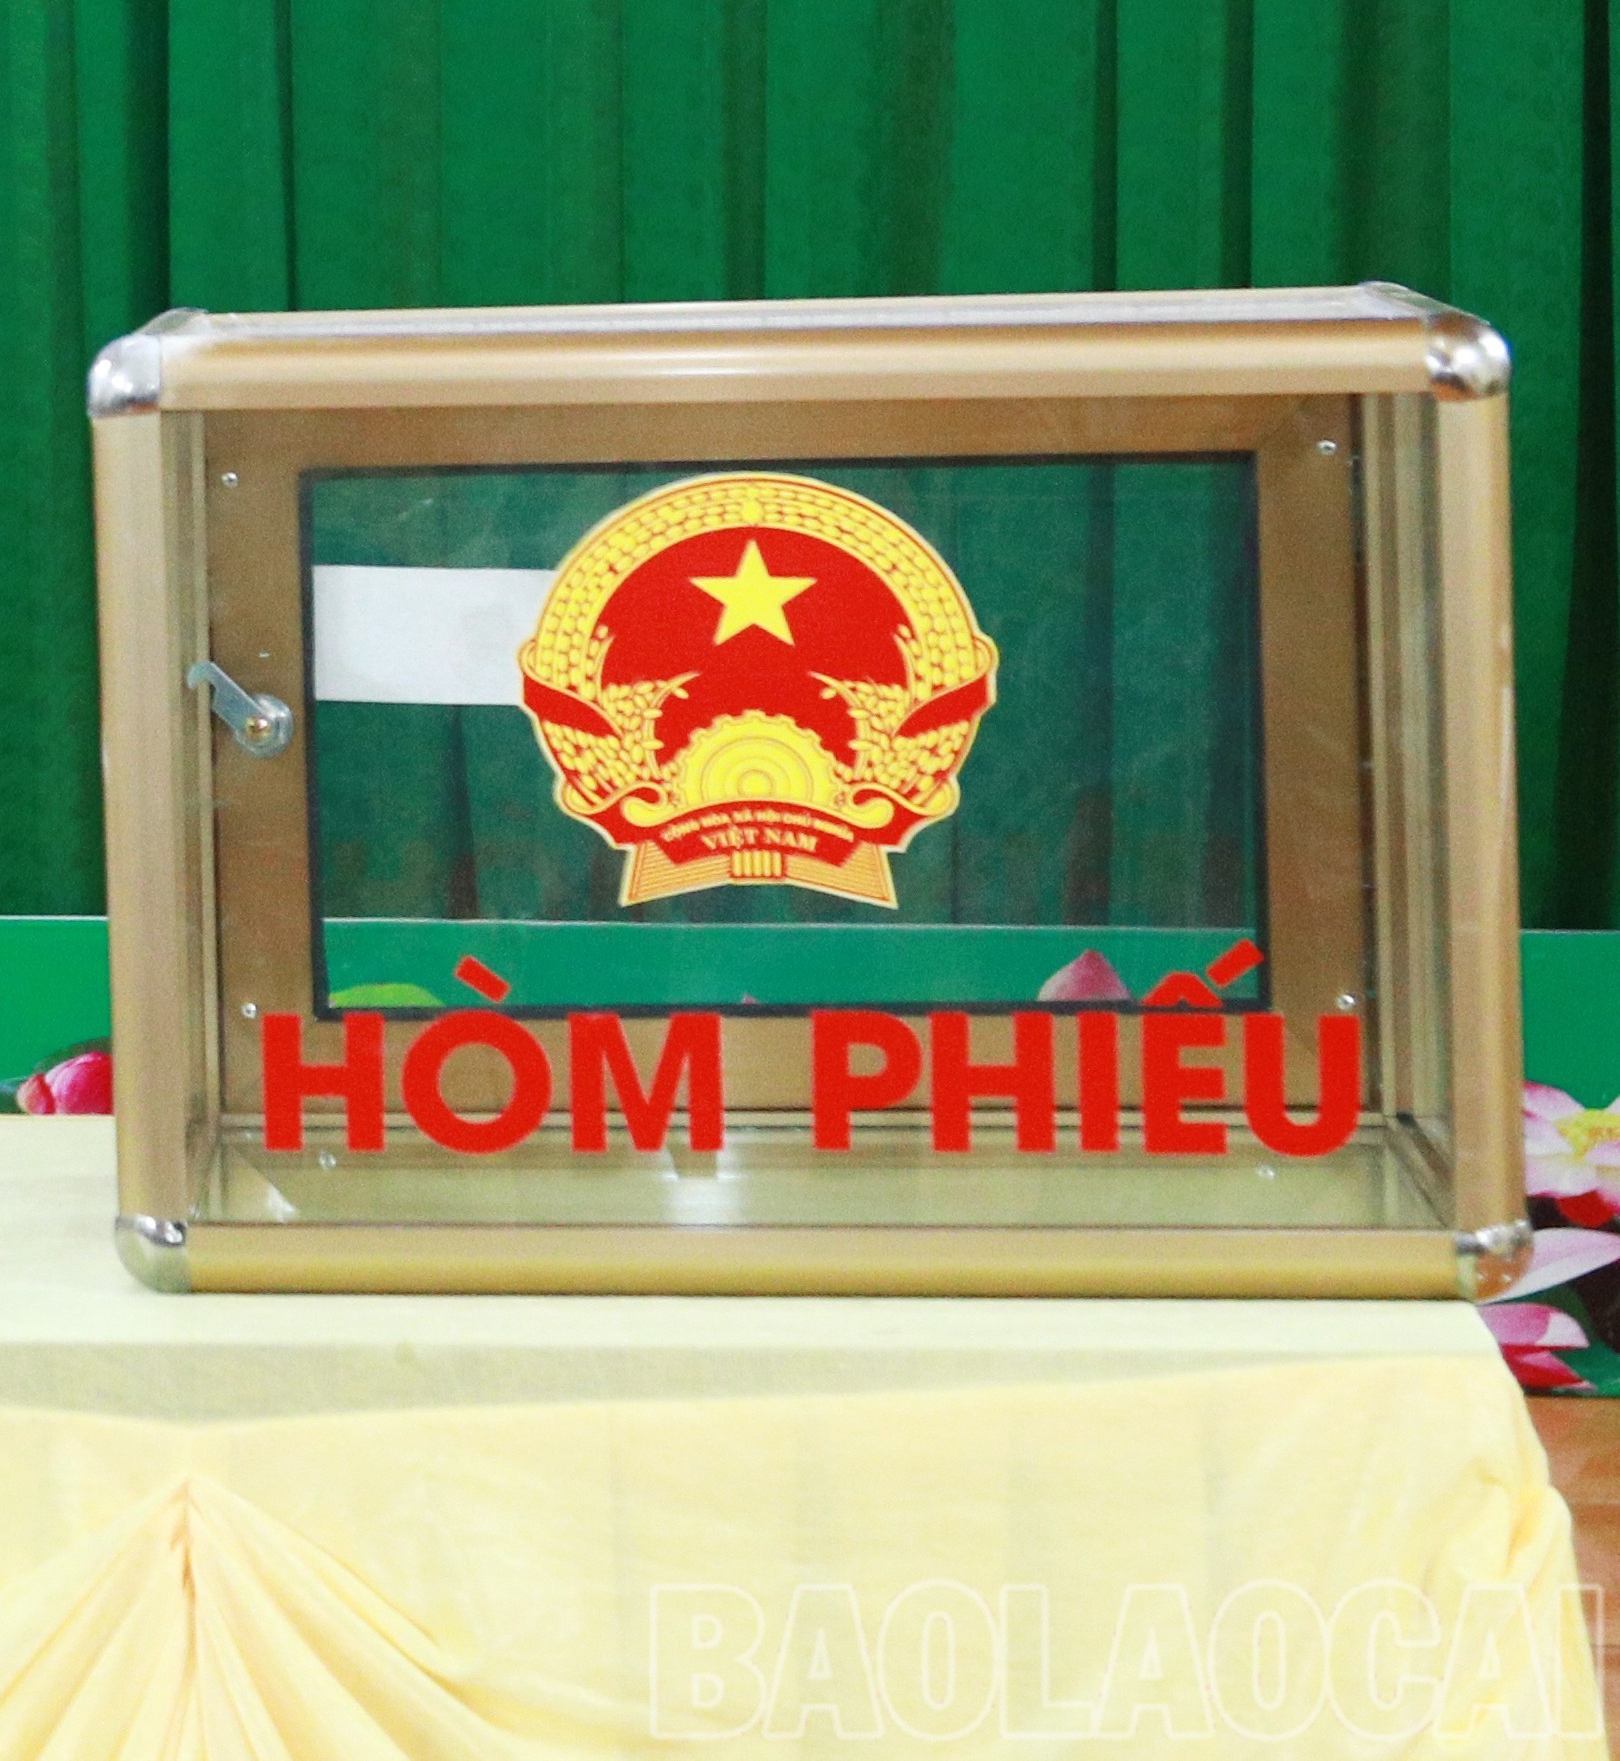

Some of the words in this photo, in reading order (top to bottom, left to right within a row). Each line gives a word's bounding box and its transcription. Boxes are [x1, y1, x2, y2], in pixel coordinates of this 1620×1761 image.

[701, 825, 759, 850] VIỆT
[762, 827, 819, 852] NAM
[263, 958, 724, 1153] HÒM
[812, 941, 1360, 1156] PHIẾU
